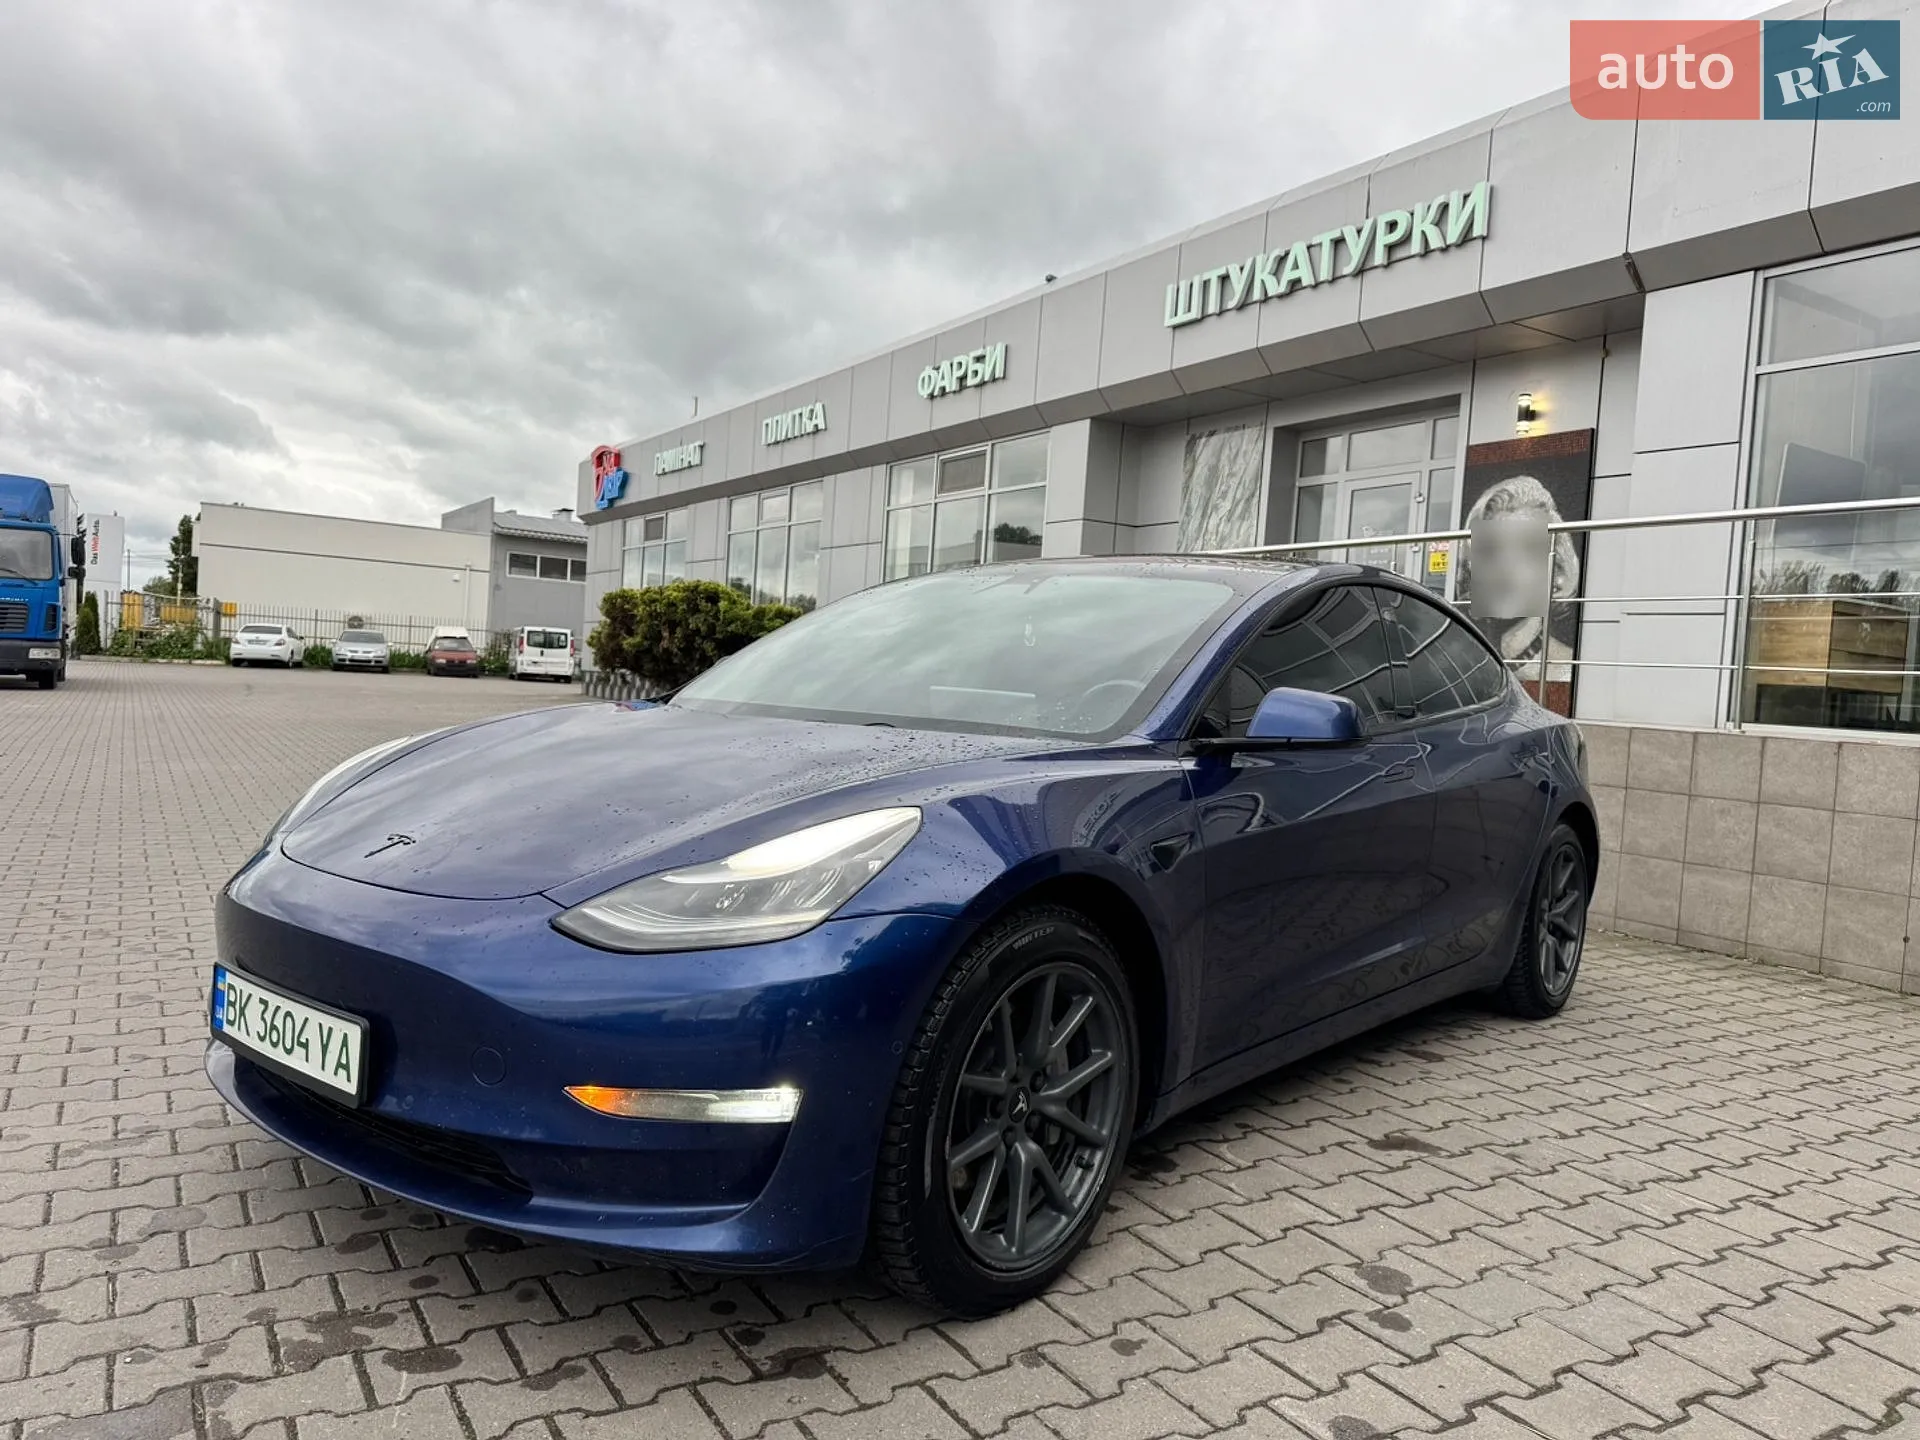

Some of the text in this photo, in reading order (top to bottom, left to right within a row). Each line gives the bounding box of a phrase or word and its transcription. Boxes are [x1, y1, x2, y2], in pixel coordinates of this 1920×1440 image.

[1163, 182, 1493, 328] ШТУКАТУРКИ
[917, 342, 1008, 399] ФАРБИ
[761, 402, 827, 446] ПЛИТКА
[225, 982, 352, 1083] BK 3604 YA
